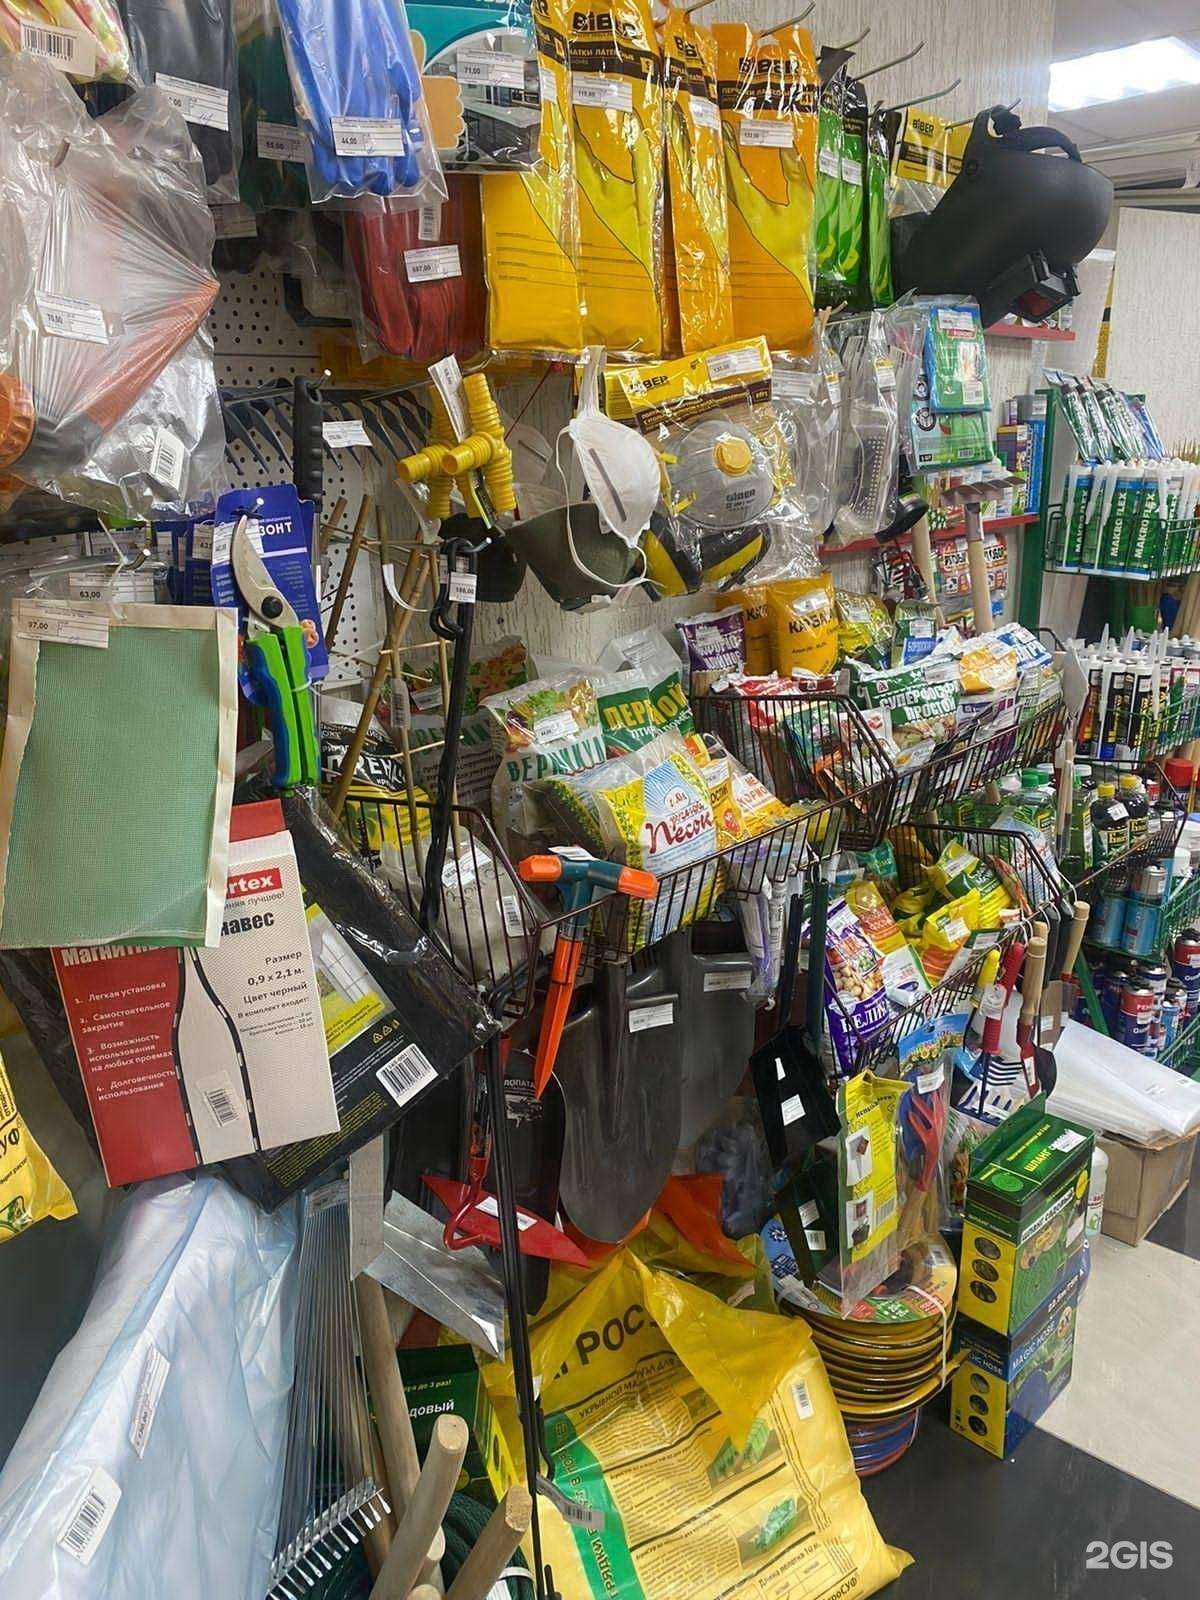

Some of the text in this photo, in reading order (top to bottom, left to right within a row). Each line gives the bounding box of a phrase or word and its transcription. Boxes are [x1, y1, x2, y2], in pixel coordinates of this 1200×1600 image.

[265, 951, 303, 965] Размер
[247, 975, 265, 986] 0,9
[275, 968, 293, 980] 2,1
[89, 989, 120, 1002] Легкая
[120, 981, 167, 998] установка
[243, 981, 308, 1005] Цвет черный
[92, 1001, 171, 1021] Самостоятельное
[82, 1020, 125, 1034] закрытие
[100, 1034, 161, 1050] Возможность
[89, 1044, 157, 1063] использования
[104, 1058, 135, 1070] любых
[135, 1051, 173, 1064] проемах
[110, 1069, 176, 1090] Долговечность
[98, 1081, 164, 1101] использования
